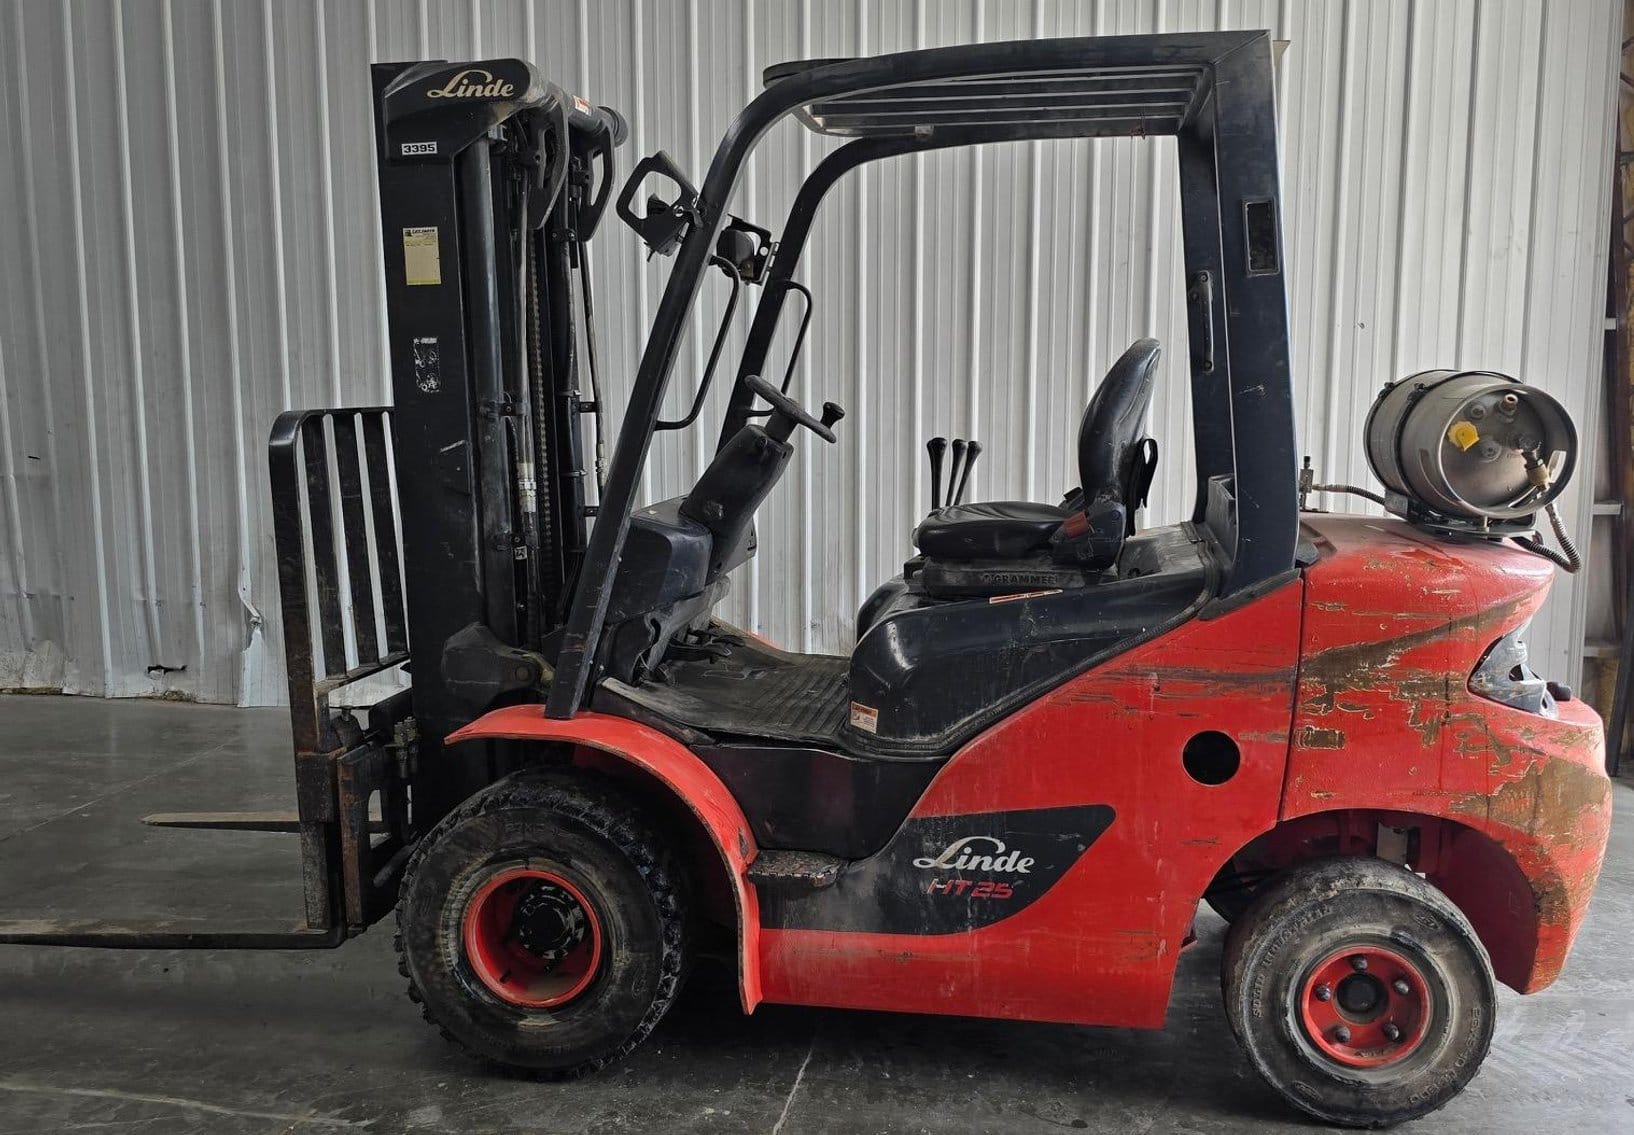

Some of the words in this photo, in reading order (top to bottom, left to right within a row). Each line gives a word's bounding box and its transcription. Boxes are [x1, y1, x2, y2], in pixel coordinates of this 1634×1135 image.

[427, 69, 514, 98] Linde
[404, 143, 435, 154] 3395
[913, 835, 1035, 874] Linde
